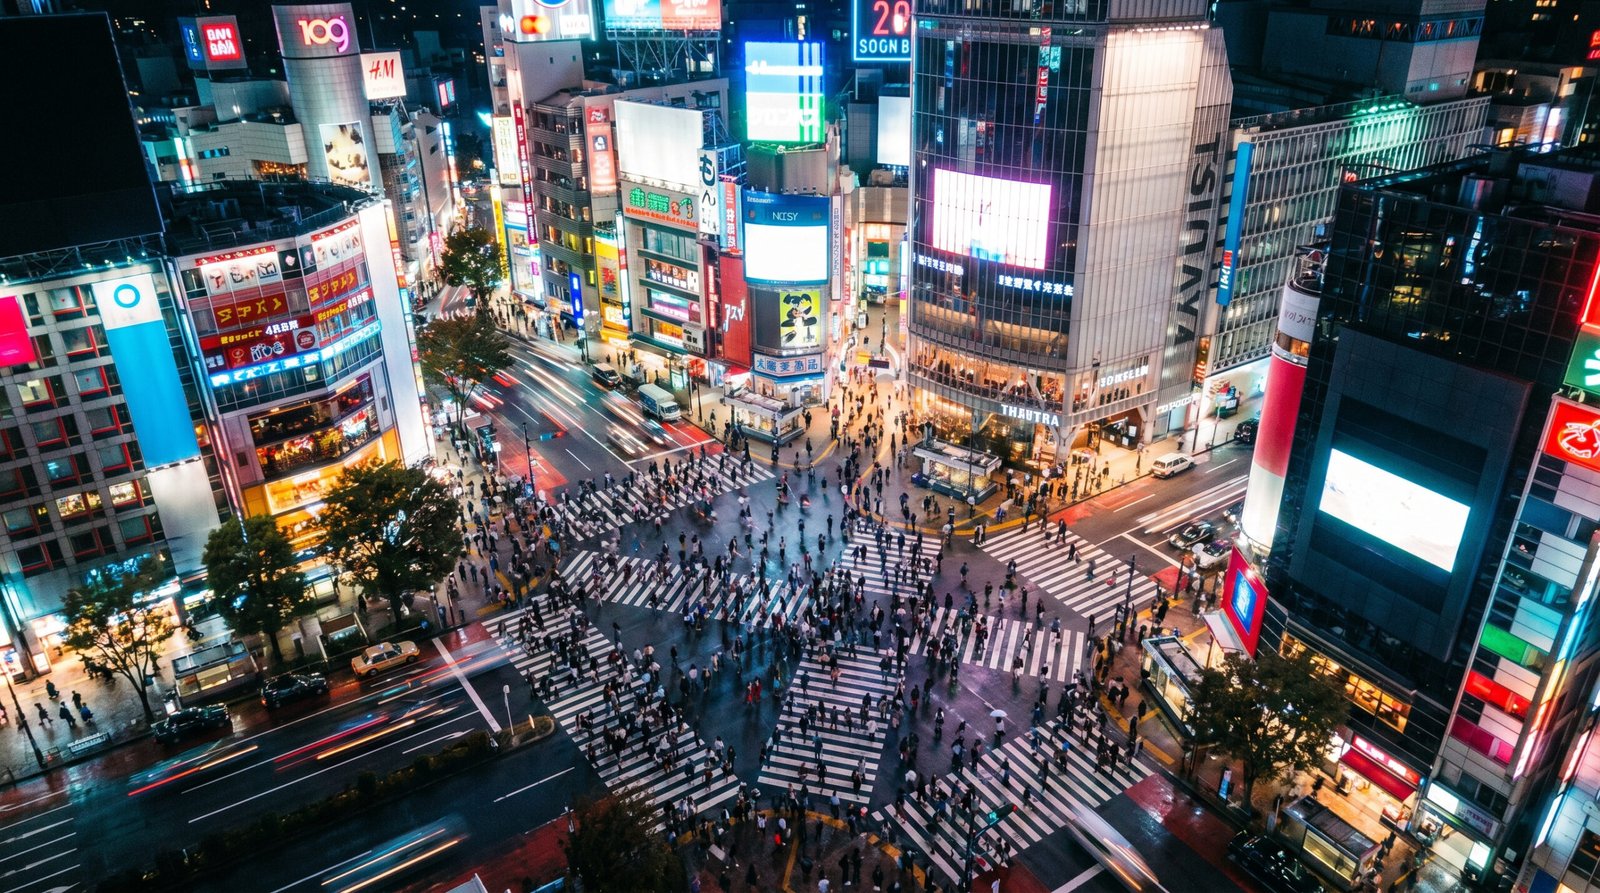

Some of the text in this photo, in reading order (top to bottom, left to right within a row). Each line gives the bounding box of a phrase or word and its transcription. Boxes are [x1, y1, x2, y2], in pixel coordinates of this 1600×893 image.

[298, 16, 349, 53] 109
[859, 38, 898, 54] SOGN
[369, 59, 395, 80] H&M
